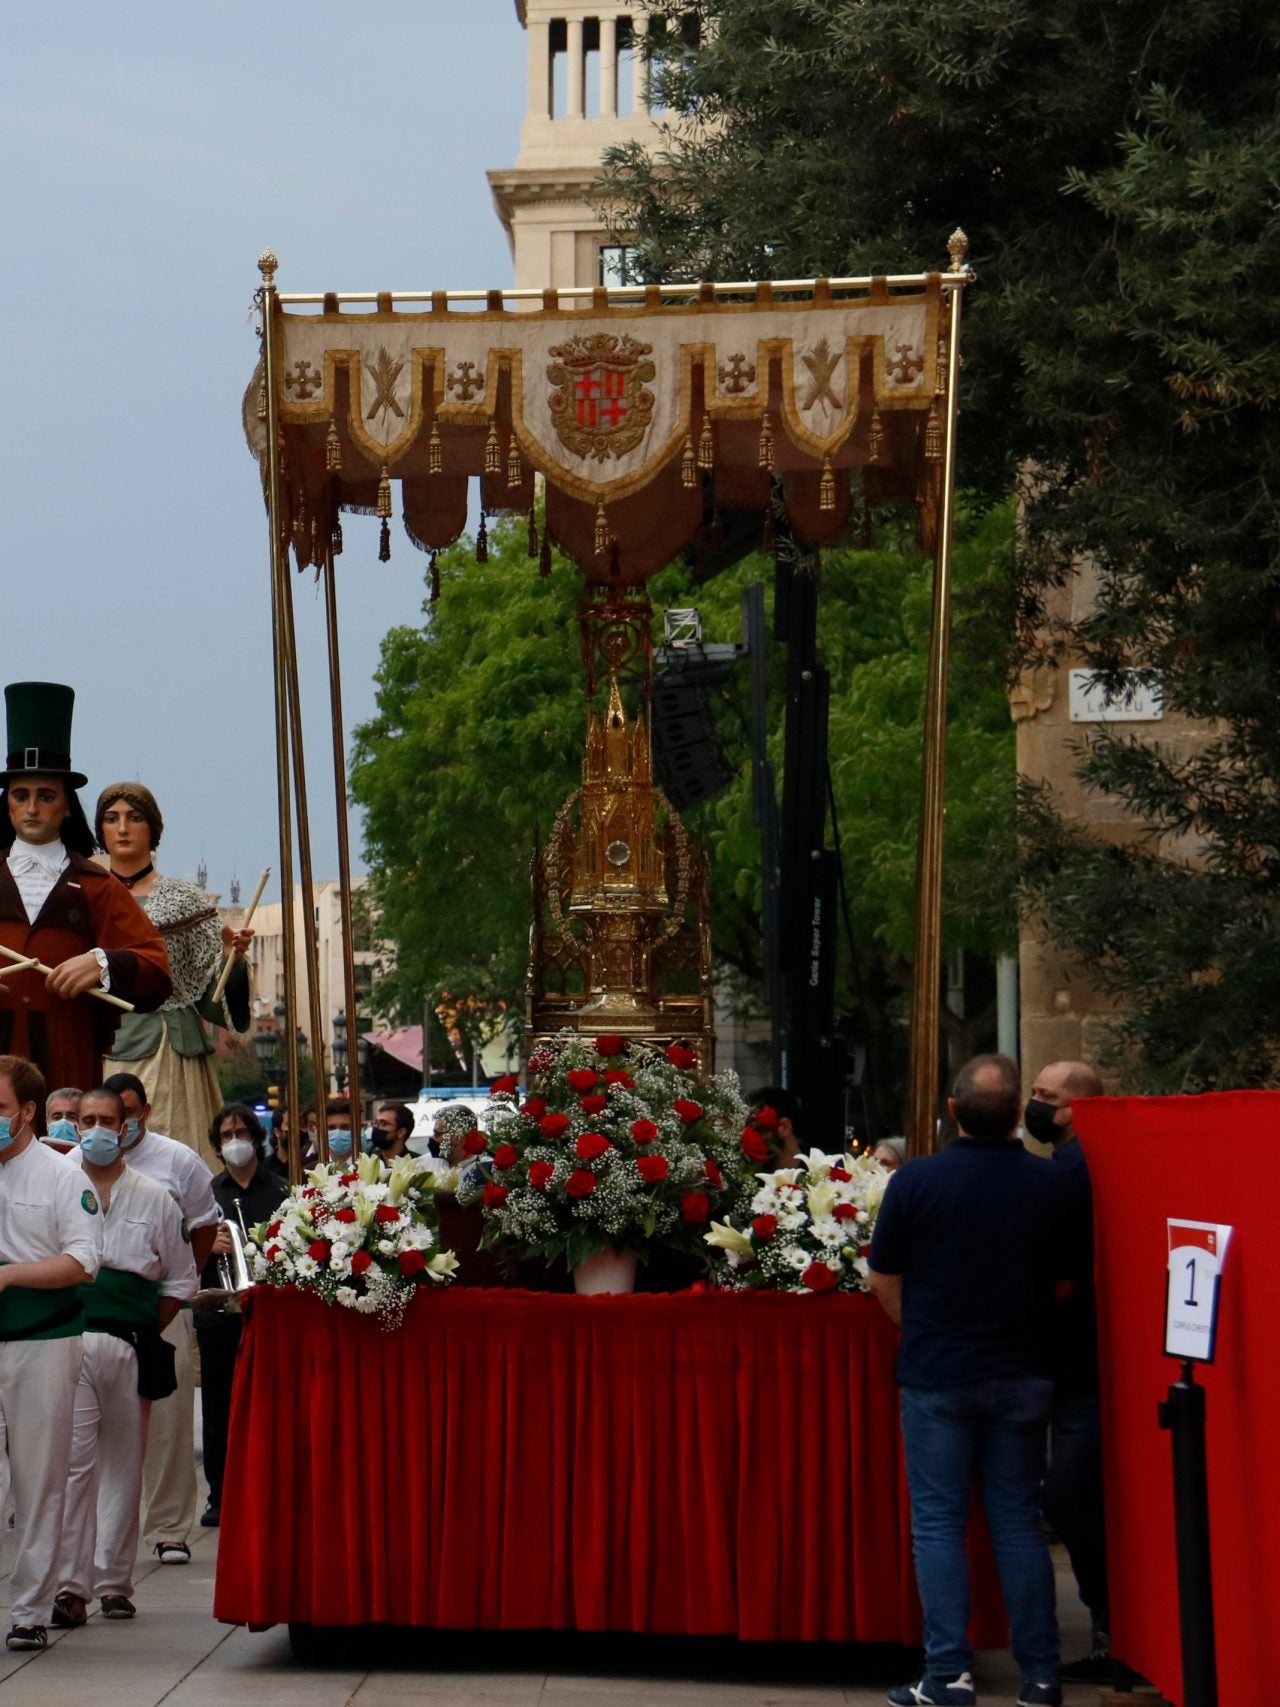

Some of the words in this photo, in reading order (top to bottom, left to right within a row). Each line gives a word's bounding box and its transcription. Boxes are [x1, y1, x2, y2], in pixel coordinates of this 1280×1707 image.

[1114, 701, 1144, 713] SEU
[812, 896, 821, 925] Tower
[810, 927, 821, 957] Super
[1184, 1258, 1198, 1306] 1
